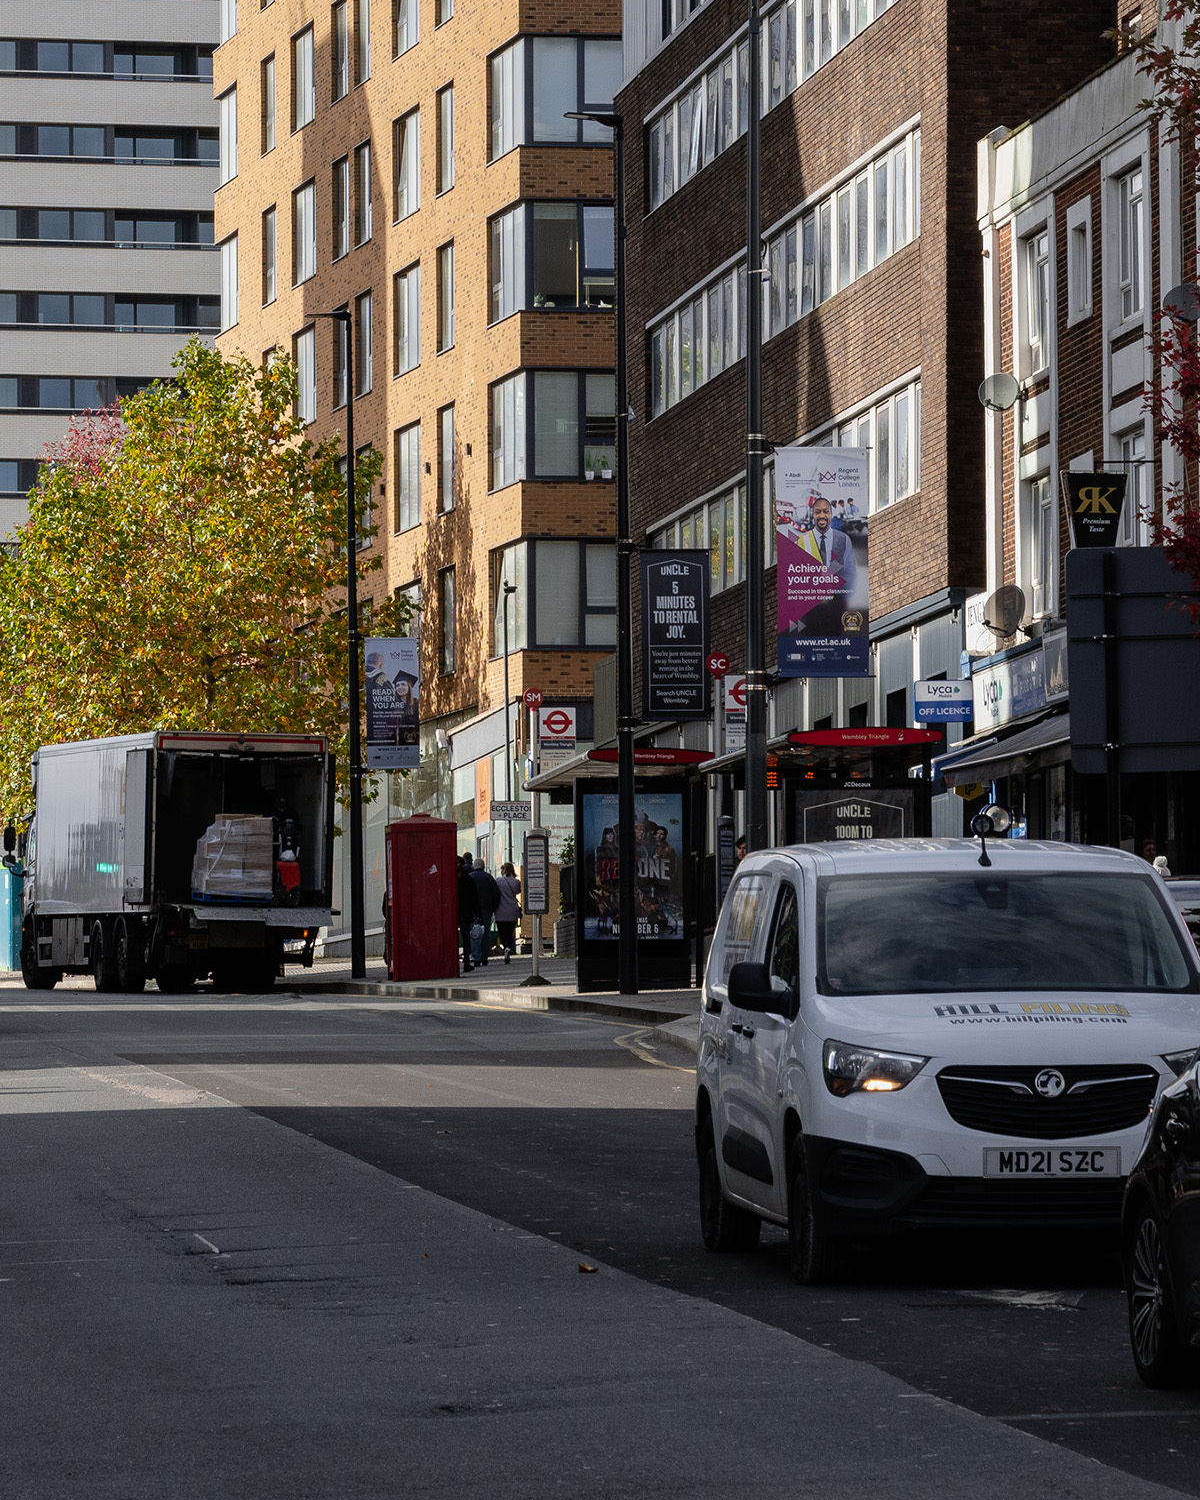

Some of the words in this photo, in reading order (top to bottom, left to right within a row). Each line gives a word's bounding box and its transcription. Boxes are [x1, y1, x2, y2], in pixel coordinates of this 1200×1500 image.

[661, 564, 690, 575] UNCLE
[788, 564, 828, 572] Achieve
[788, 576, 810, 586] your
[812, 574, 839, 586] goals
[672, 582, 678, 594] 5
[656, 596, 695, 609] MINUTES
[653, 610, 666, 624] TO
[666, 610, 698, 624] RENTAL
[666, 626, 686, 638] JOY.
[710, 659, 726, 669] SC
[674, 672, 700, 680] Wembley.
[928, 685, 952, 696] Lyca
[526, 693, 541, 702] SM
[936, 707, 970, 715] LICENCE
[836, 805, 871, 818] UNCLE
[835, 825, 860, 838] 100M
[862, 825, 873, 838] TO
[638, 858, 670, 880] ONE
[654, 924, 659, 934] 6
[934, 1004, 1008, 1016] HILL
[1020, 1004, 1130, 1016] PILING
[950, 1015, 1128, 1025] www.hillpiling.com
[1000, 1152, 1052, 1173] MD21
[1059, 1151, 1105, 1172] SZC
